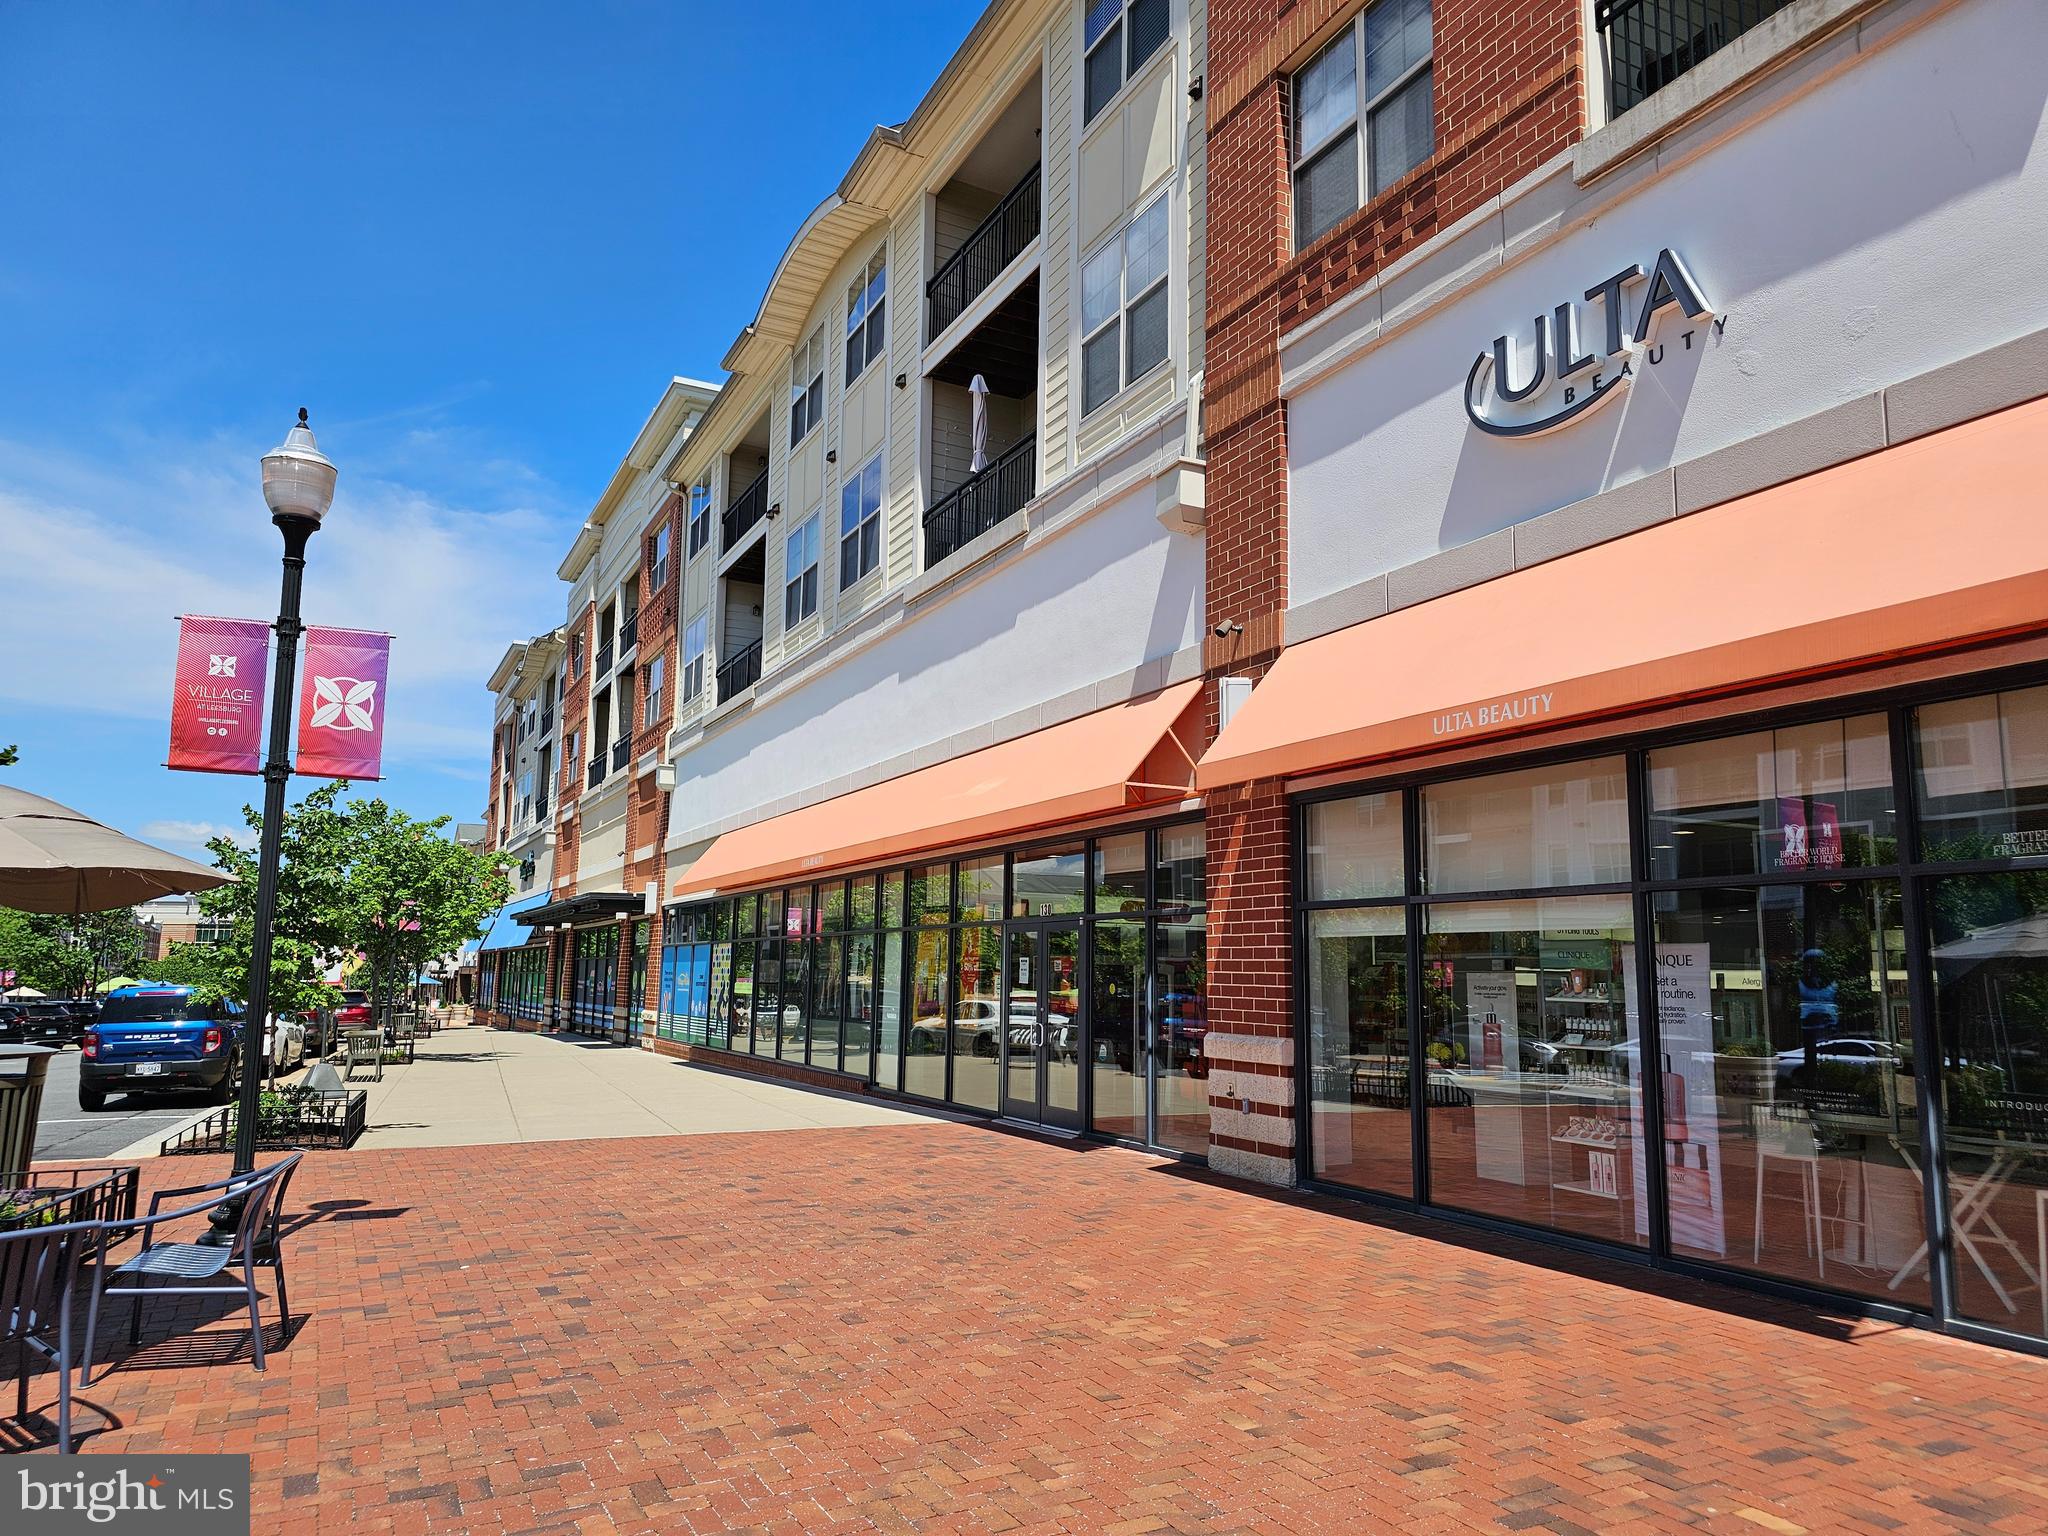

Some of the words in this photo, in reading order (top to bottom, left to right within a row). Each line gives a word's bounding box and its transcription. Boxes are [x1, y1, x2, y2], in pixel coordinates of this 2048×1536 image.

[1494, 248, 1714, 403] ULTA
[1564, 315, 1728, 405] BEAUTY
[188, 684, 253, 701] VILLAGE
[207, 705, 242, 713] LEESBURG
[1433, 711, 1474, 735] ULTA
[1479, 692, 1553, 726] BEAUTY
[1810, 846, 1838, 856] WORLD
[1774, 854, 1819, 866] FRAGRANCE
[1820, 853, 1846, 863] HOUSE
[1040, 903, 1052, 916] 130
[1558, 951, 1590, 960] CLINIQUE
[1661, 988, 1696, 999] routine.
